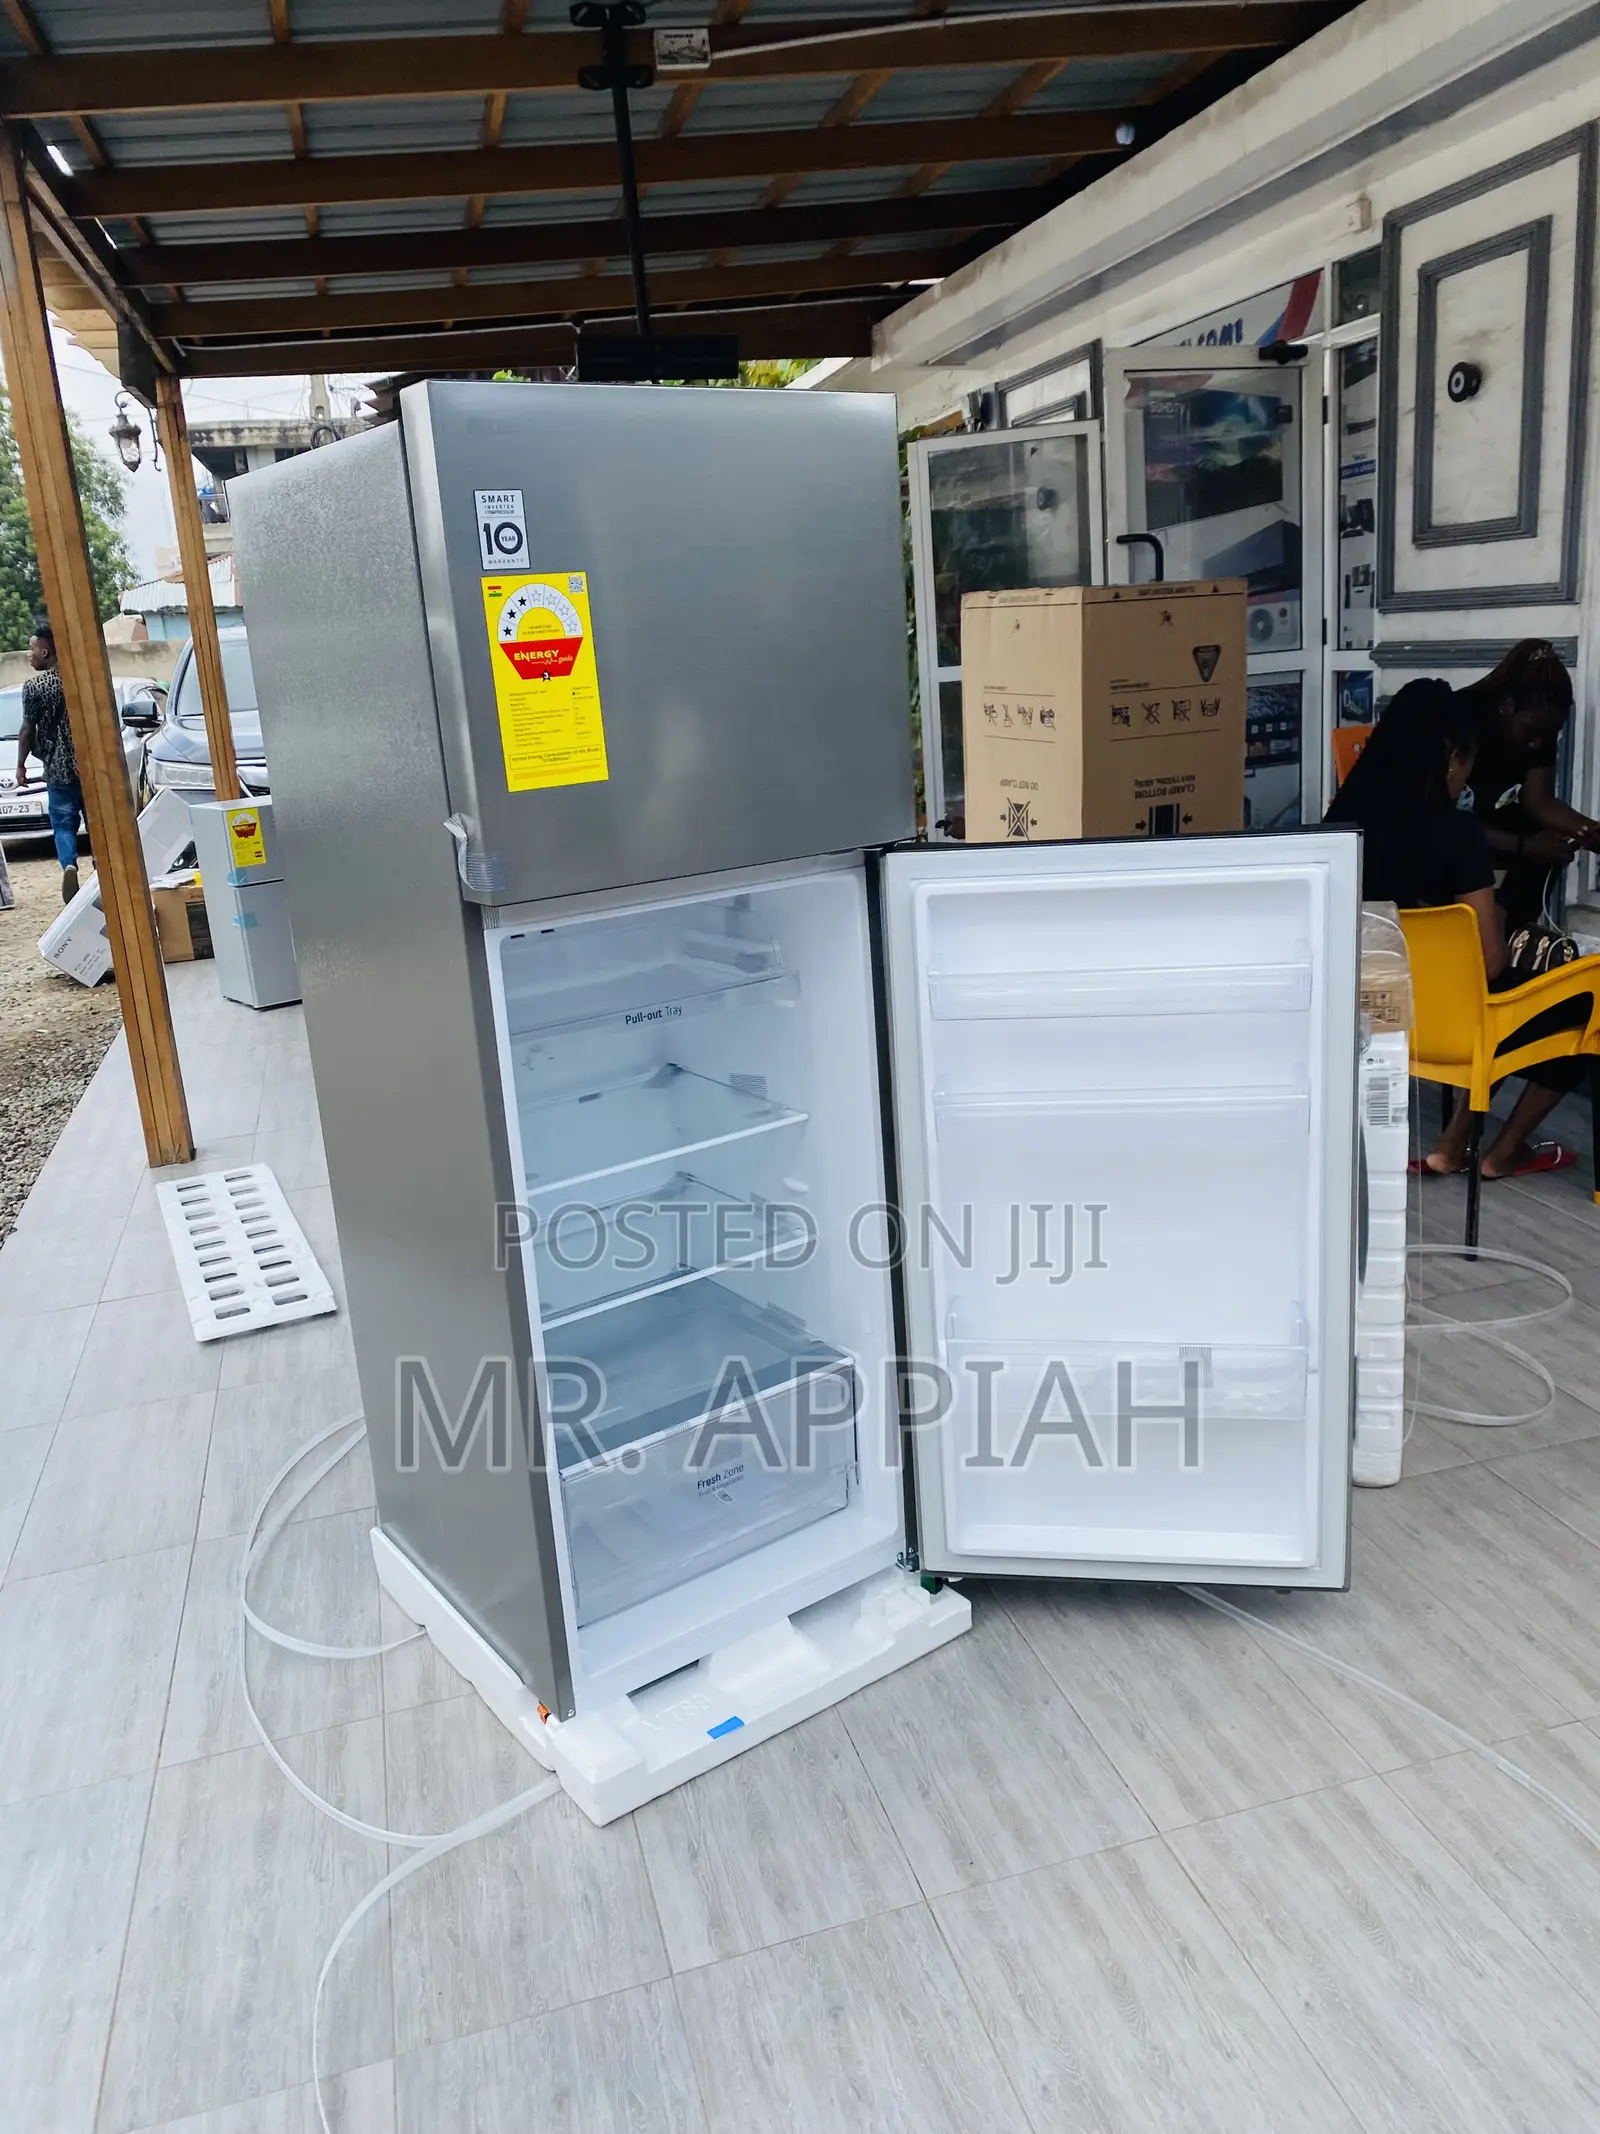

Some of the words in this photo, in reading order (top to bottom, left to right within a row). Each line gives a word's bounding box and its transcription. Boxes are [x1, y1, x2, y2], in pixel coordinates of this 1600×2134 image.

[481, 494, 515, 504] SMART
[483, 521, 523, 555] 10
[513, 649, 559, 662] ENERGY
[543, 671, 549, 679] 3
[1030, 782, 1039, 790] DO
[1168, 784, 1195, 795] CLAMP
[1134, 787, 1167, 800] BOTTOM
[53, 936, 72, 959] SONY
[624, 1009, 663, 1025] Pull-out
[664, 1004, 683, 1017] Tray
[697, 1473, 721, 1490] Fresh
[723, 1464, 744, 1480] Zone
